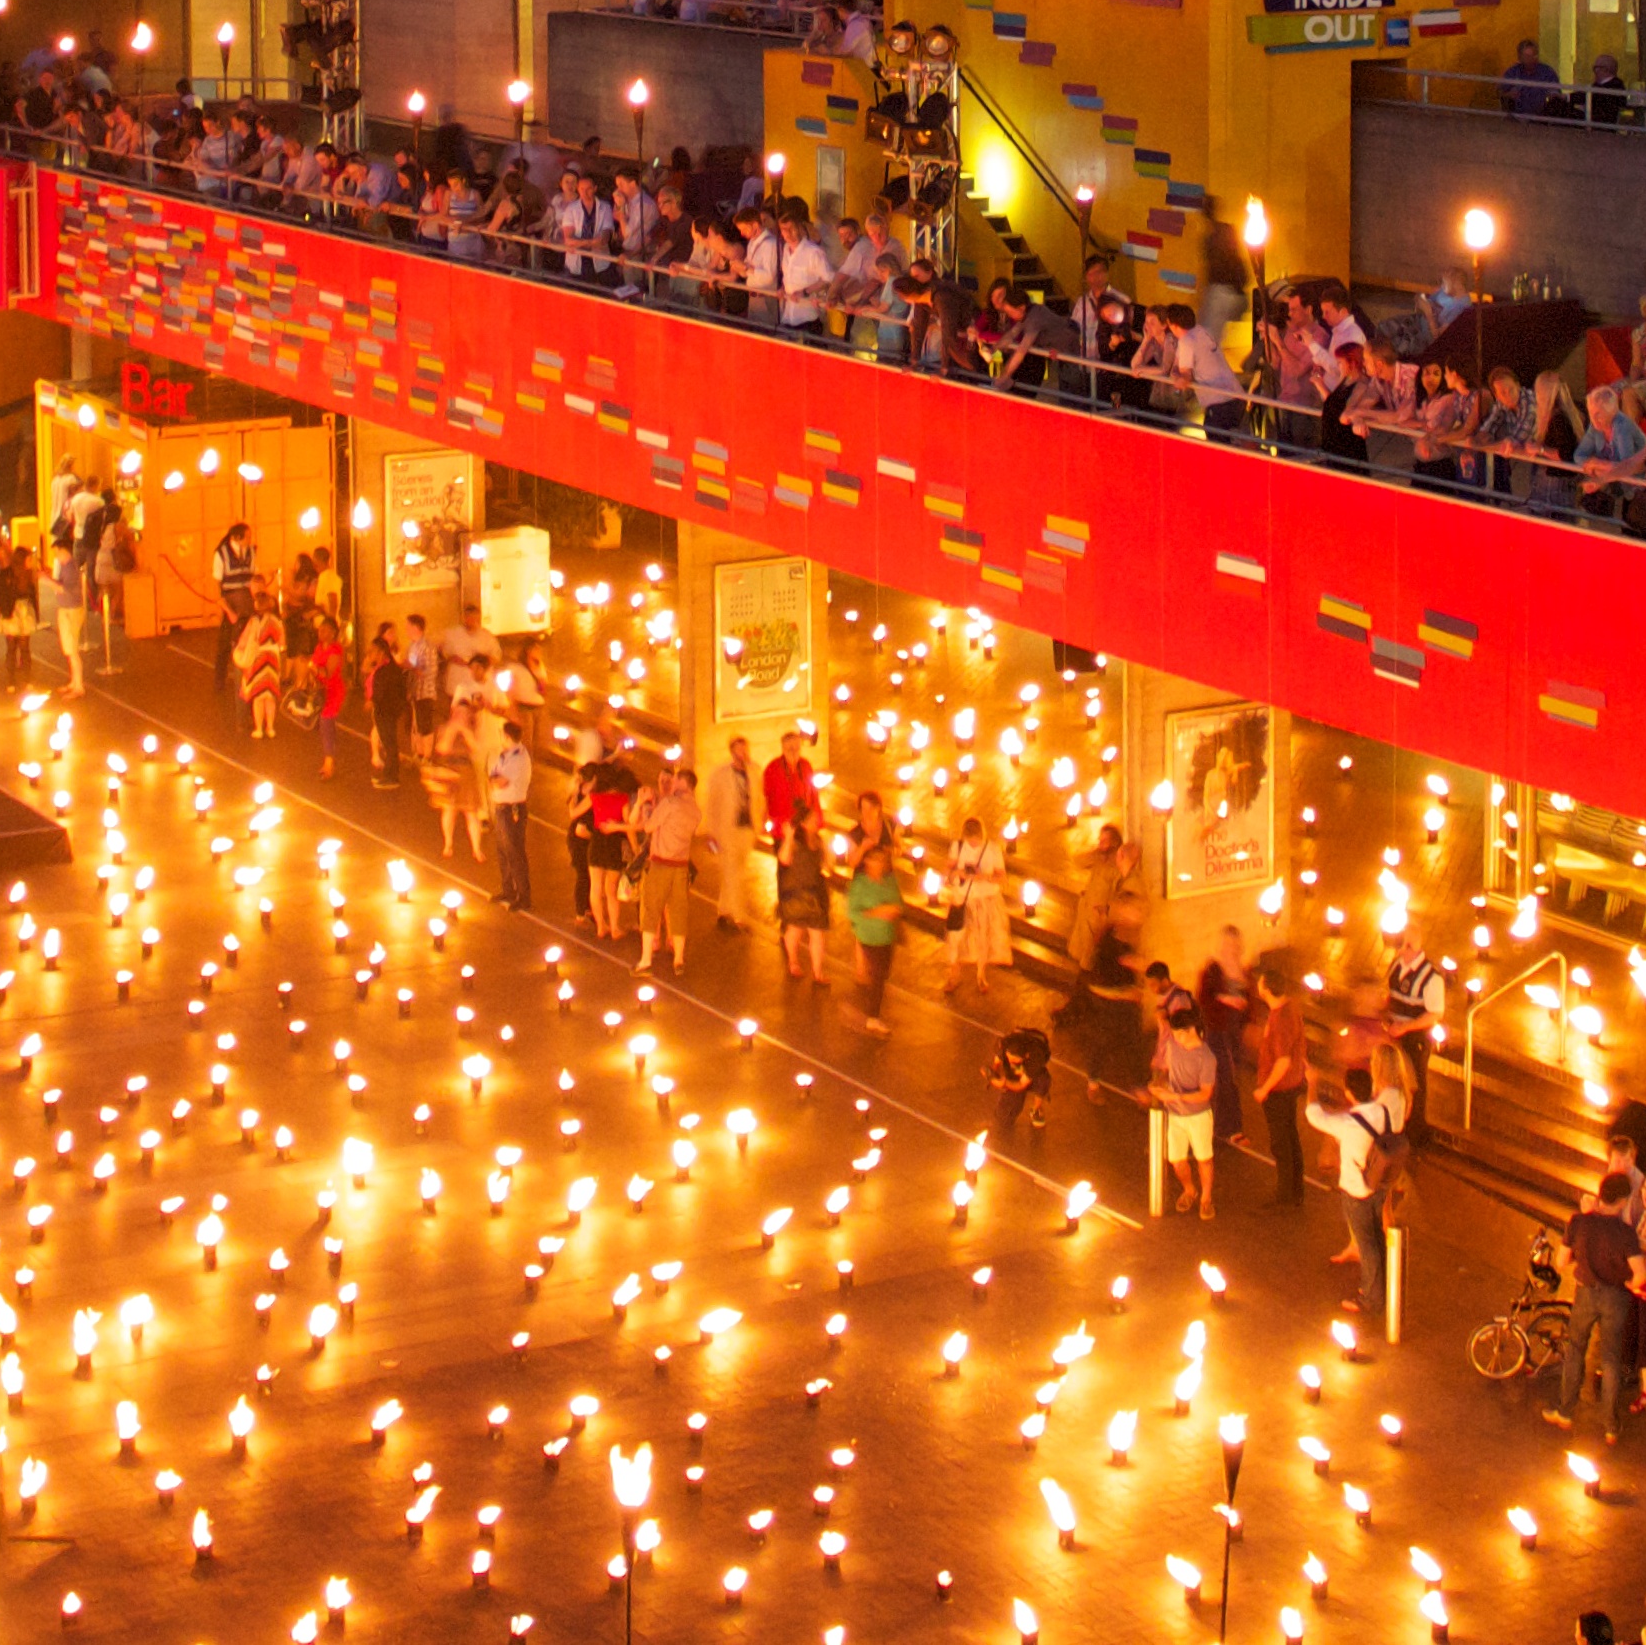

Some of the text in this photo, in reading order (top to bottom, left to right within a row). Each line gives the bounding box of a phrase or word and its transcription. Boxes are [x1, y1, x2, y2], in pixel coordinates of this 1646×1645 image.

[1303, 14, 1375, 44] OUT
[121, 362, 195, 419] Bar
[740, 652, 787, 669] London
[1205, 837, 1260, 860] Doctor's
[1205, 855, 1264, 877] Dilemma
